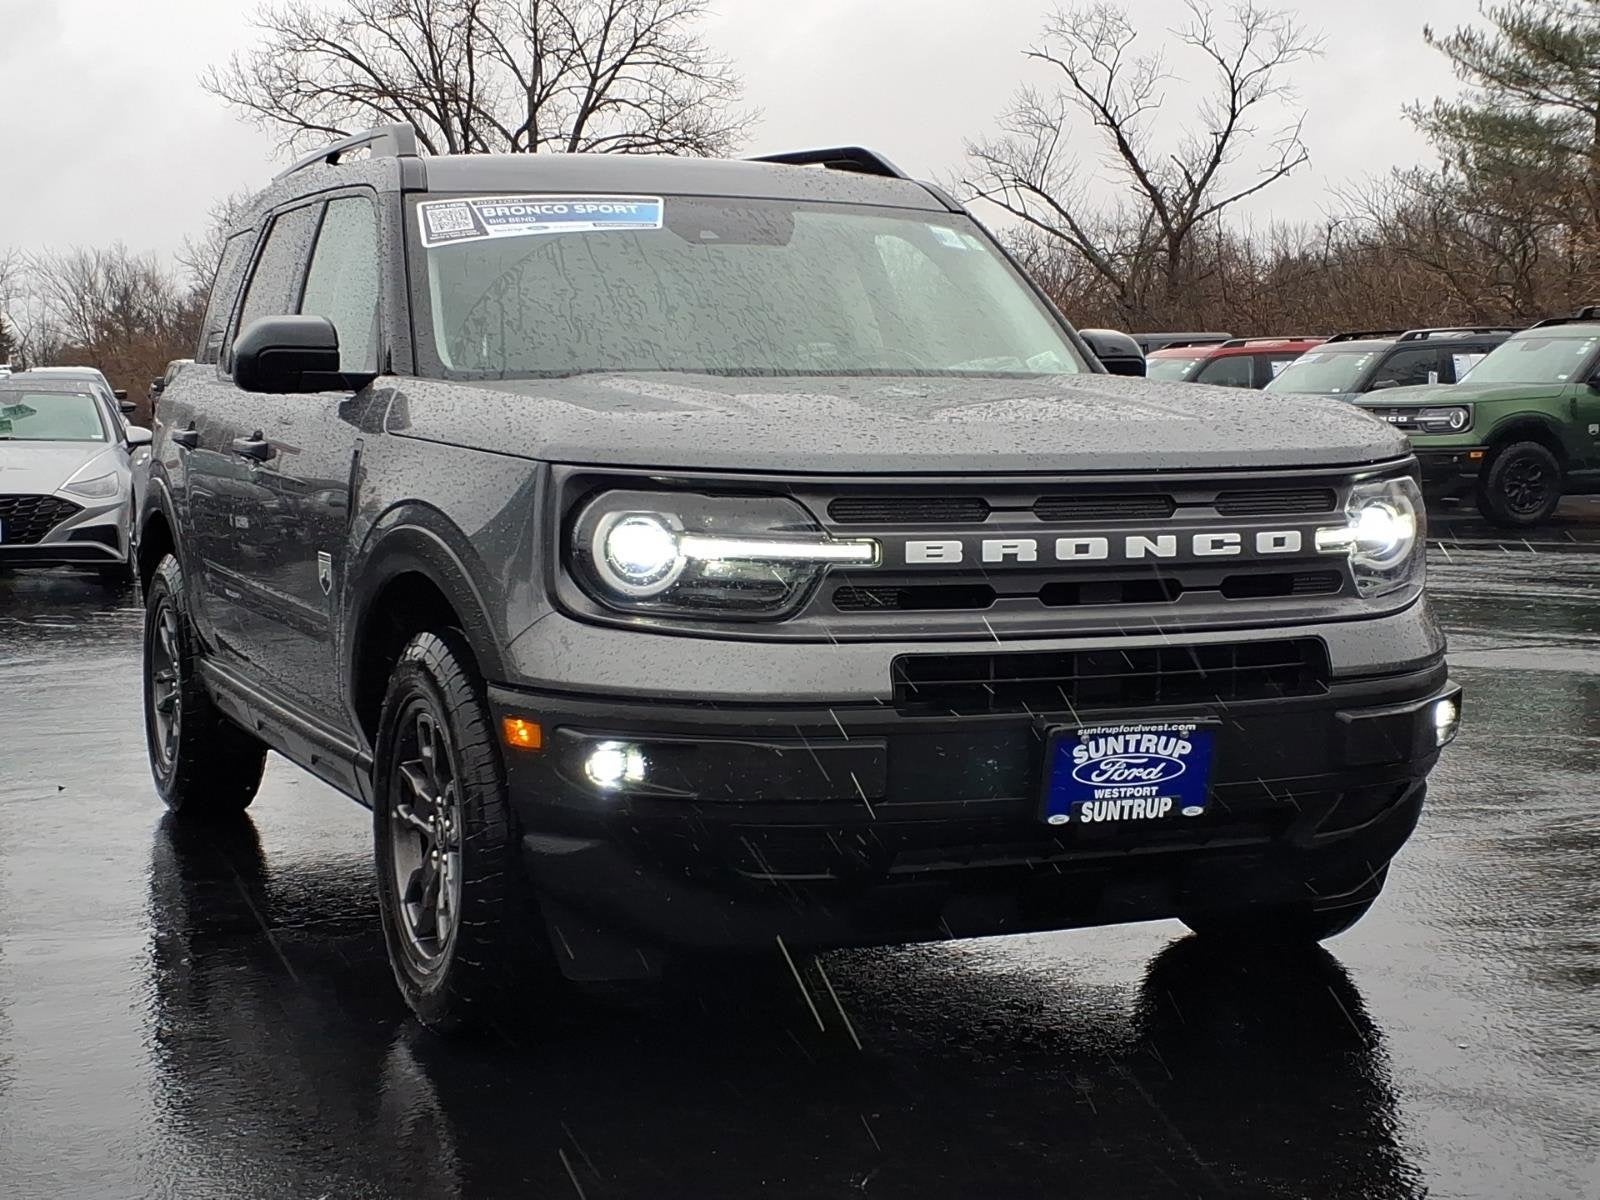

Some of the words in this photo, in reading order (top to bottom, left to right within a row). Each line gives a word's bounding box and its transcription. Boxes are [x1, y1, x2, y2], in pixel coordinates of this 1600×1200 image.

[484, 204, 570, 218] BRONCO
[574, 204, 639, 215] SPORT
[489, 216, 506, 224] BIG
[508, 215, 537, 224] BEND
[905, 530, 1302, 564] BRONCO
[1077, 724, 1197, 736] suntrupfordwest.com
[1072, 733, 1193, 765] SUNTRUP
[1091, 757, 1167, 782] Ford
[1094, 786, 1159, 799] WESTPORT
[1080, 797, 1173, 824] SUNTRUP
